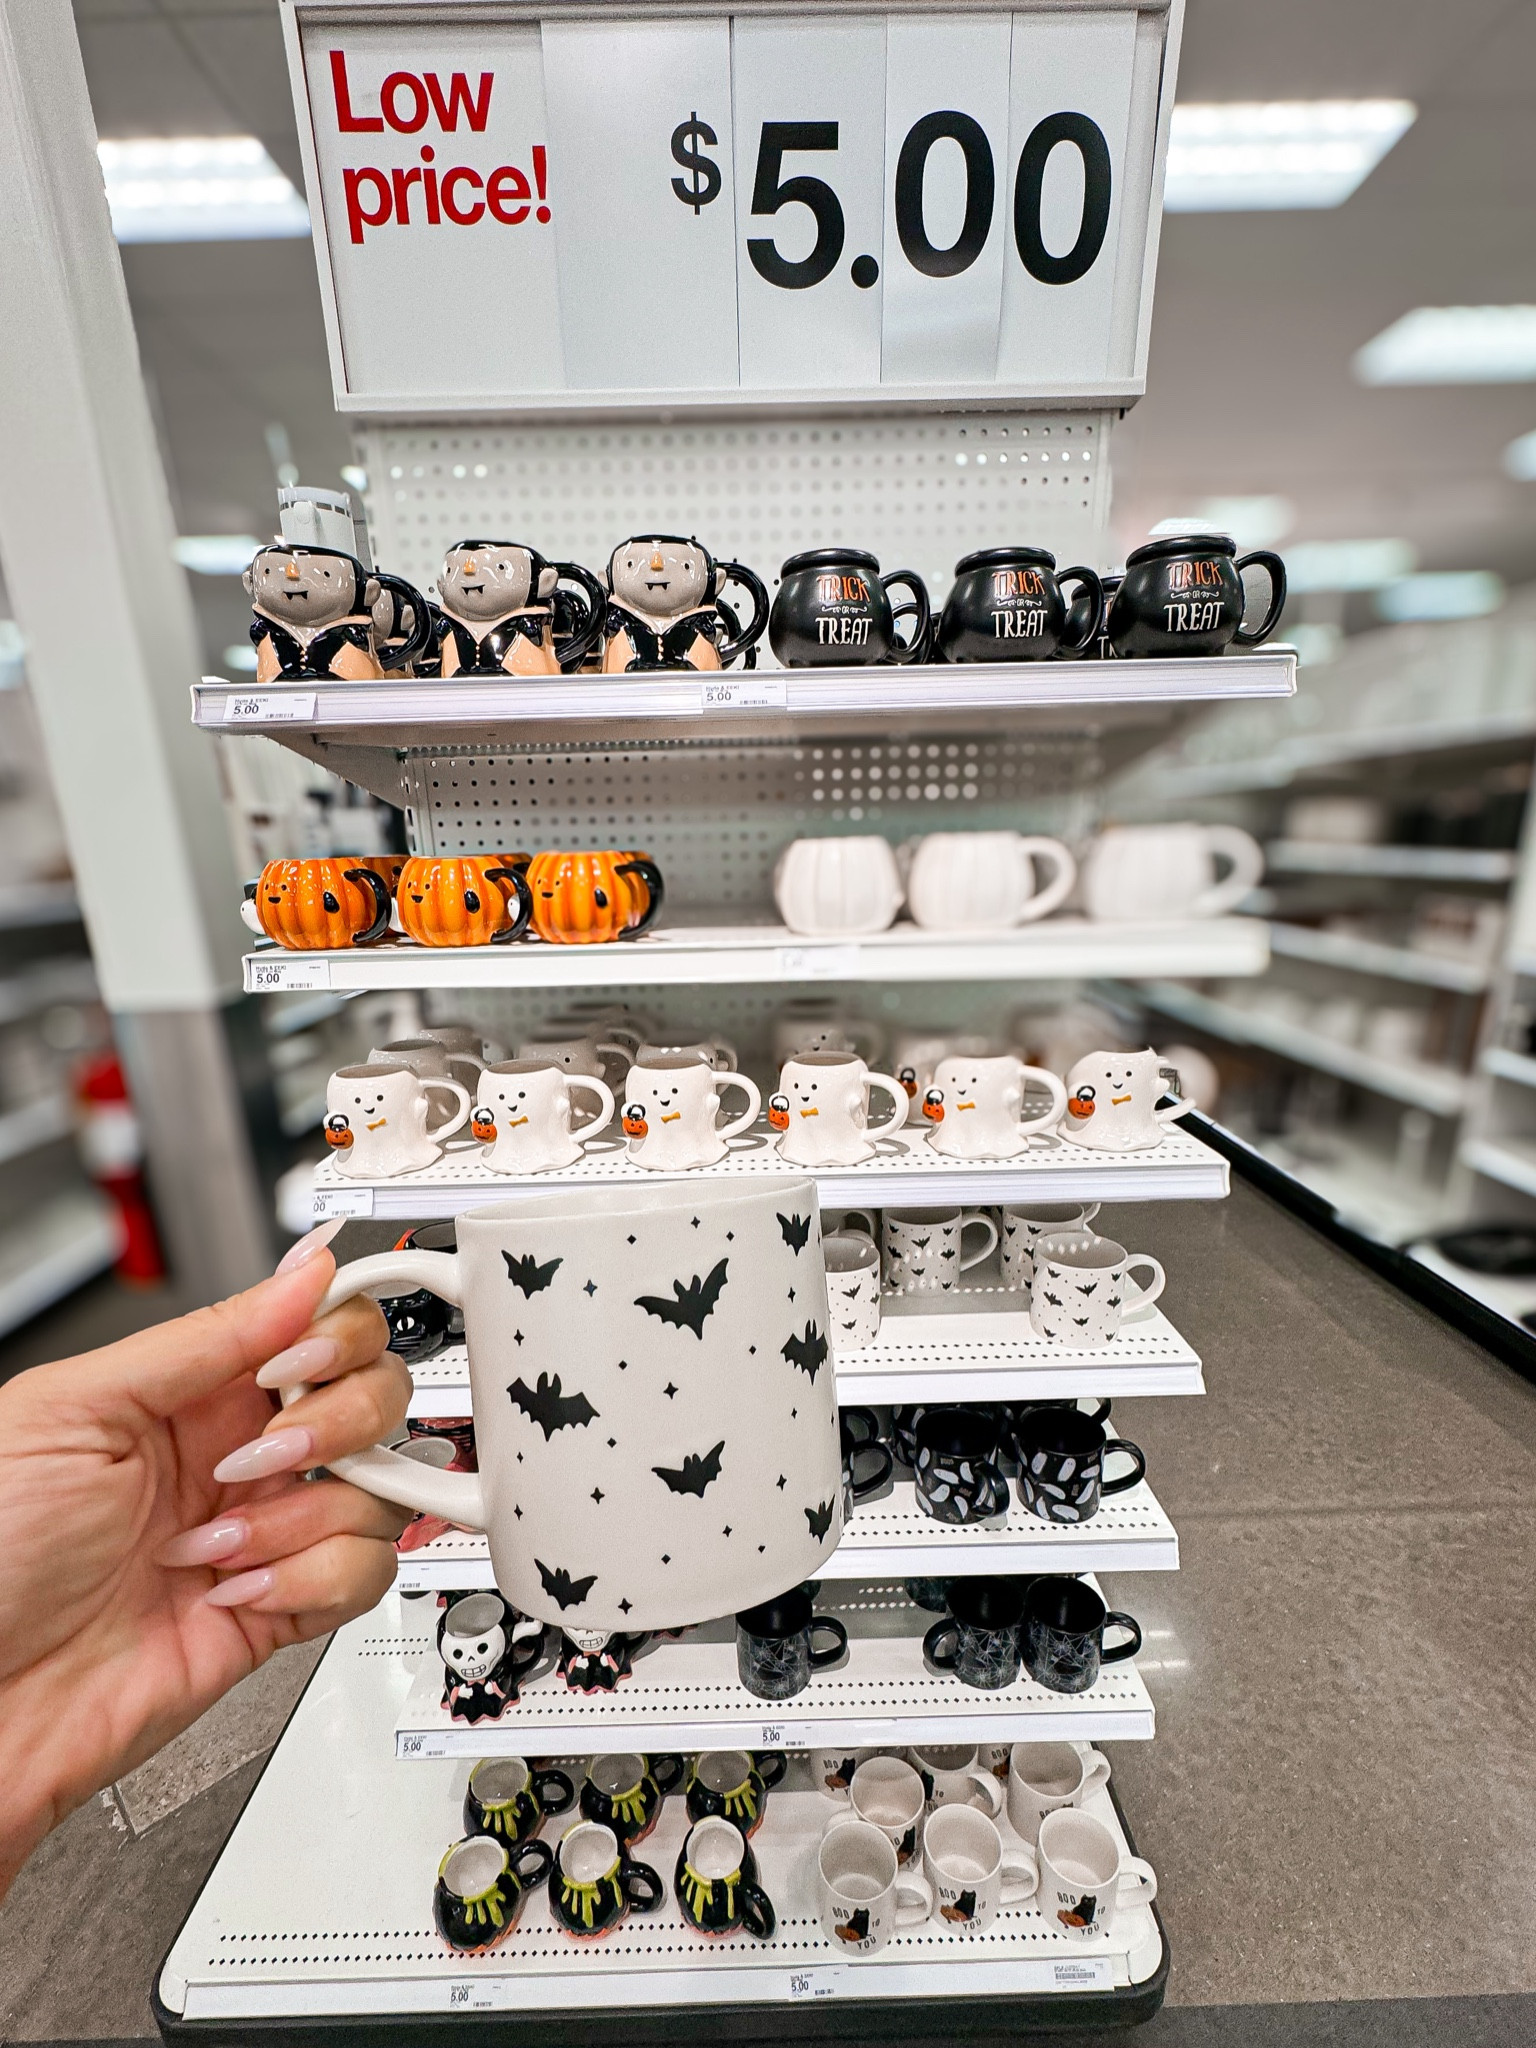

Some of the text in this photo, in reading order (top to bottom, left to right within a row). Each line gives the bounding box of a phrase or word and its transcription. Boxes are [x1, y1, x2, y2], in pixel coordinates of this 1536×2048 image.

[329, 50, 494, 134] Low
[342, 145, 552, 245] price!
[1166, 561, 1223, 590] TRICK
[816, 574, 871, 603] TRICK
[991, 570, 1046, 598] TRICK
[990, 609, 1048, 639] TREAT
[1163, 601, 1225, 633] TREAT
[815, 616, 873, 646] TREAT
[707, 691, 732, 702] 5.00
[233, 704, 259, 715] 5.00
[256, 973, 280, 984] 5.00
[762, 1732, 780, 1742] 5.00
[403, 1742, 422, 1752] 5.00
[939, 1886, 957, 1901] BOO
[1057, 1891, 1076, 1905] BOO
[832, 1906, 850, 1920] BOO
[962, 1917, 982, 1931] YOU
[1080, 1923, 1100, 1936] YOU
[857, 1936, 877, 1950] YOU
[791, 1980, 809, 1991] 5.00
